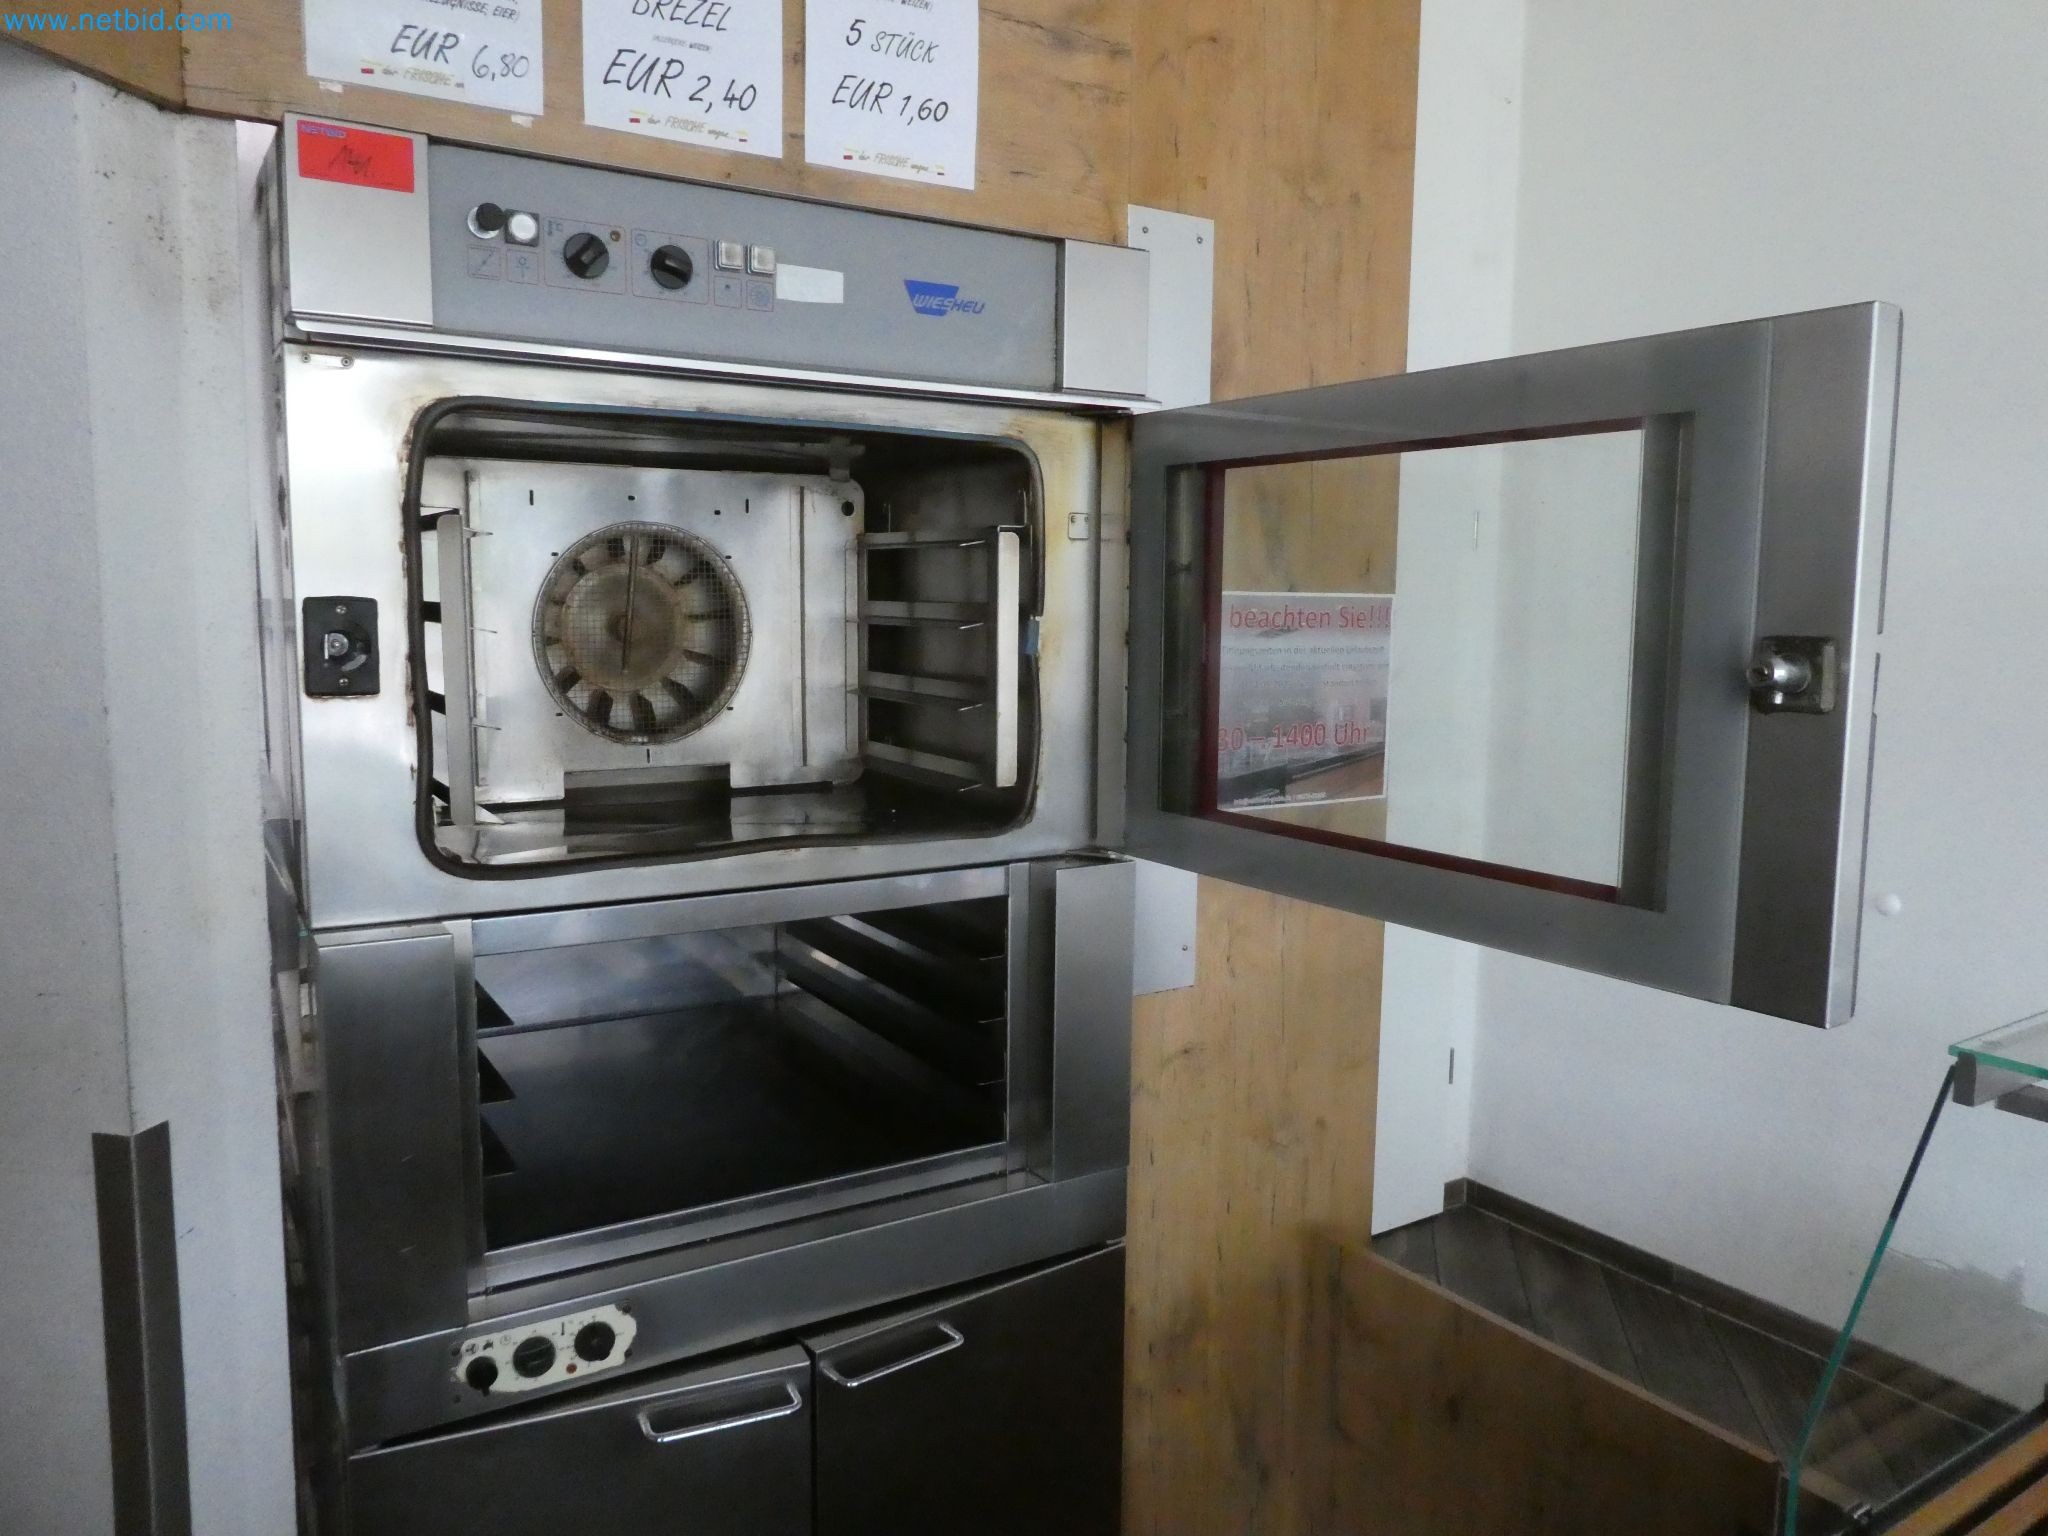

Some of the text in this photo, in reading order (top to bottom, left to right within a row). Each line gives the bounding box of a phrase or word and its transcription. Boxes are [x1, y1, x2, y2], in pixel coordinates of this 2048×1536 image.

[390, 24, 529, 81] EUR 6,80
[845, 19, 939, 63] 5 STÜCK
[602, 49, 757, 113] EUR 2,40
[832, 75, 949, 126] EUR 1,60
[913, 294, 985, 315] WIESHEU
[1229, 604, 1391, 629] beachten Sie!!!
[1272, 722, 1326, 749] 1400
[1334, 720, 1371, 745] Uhr
